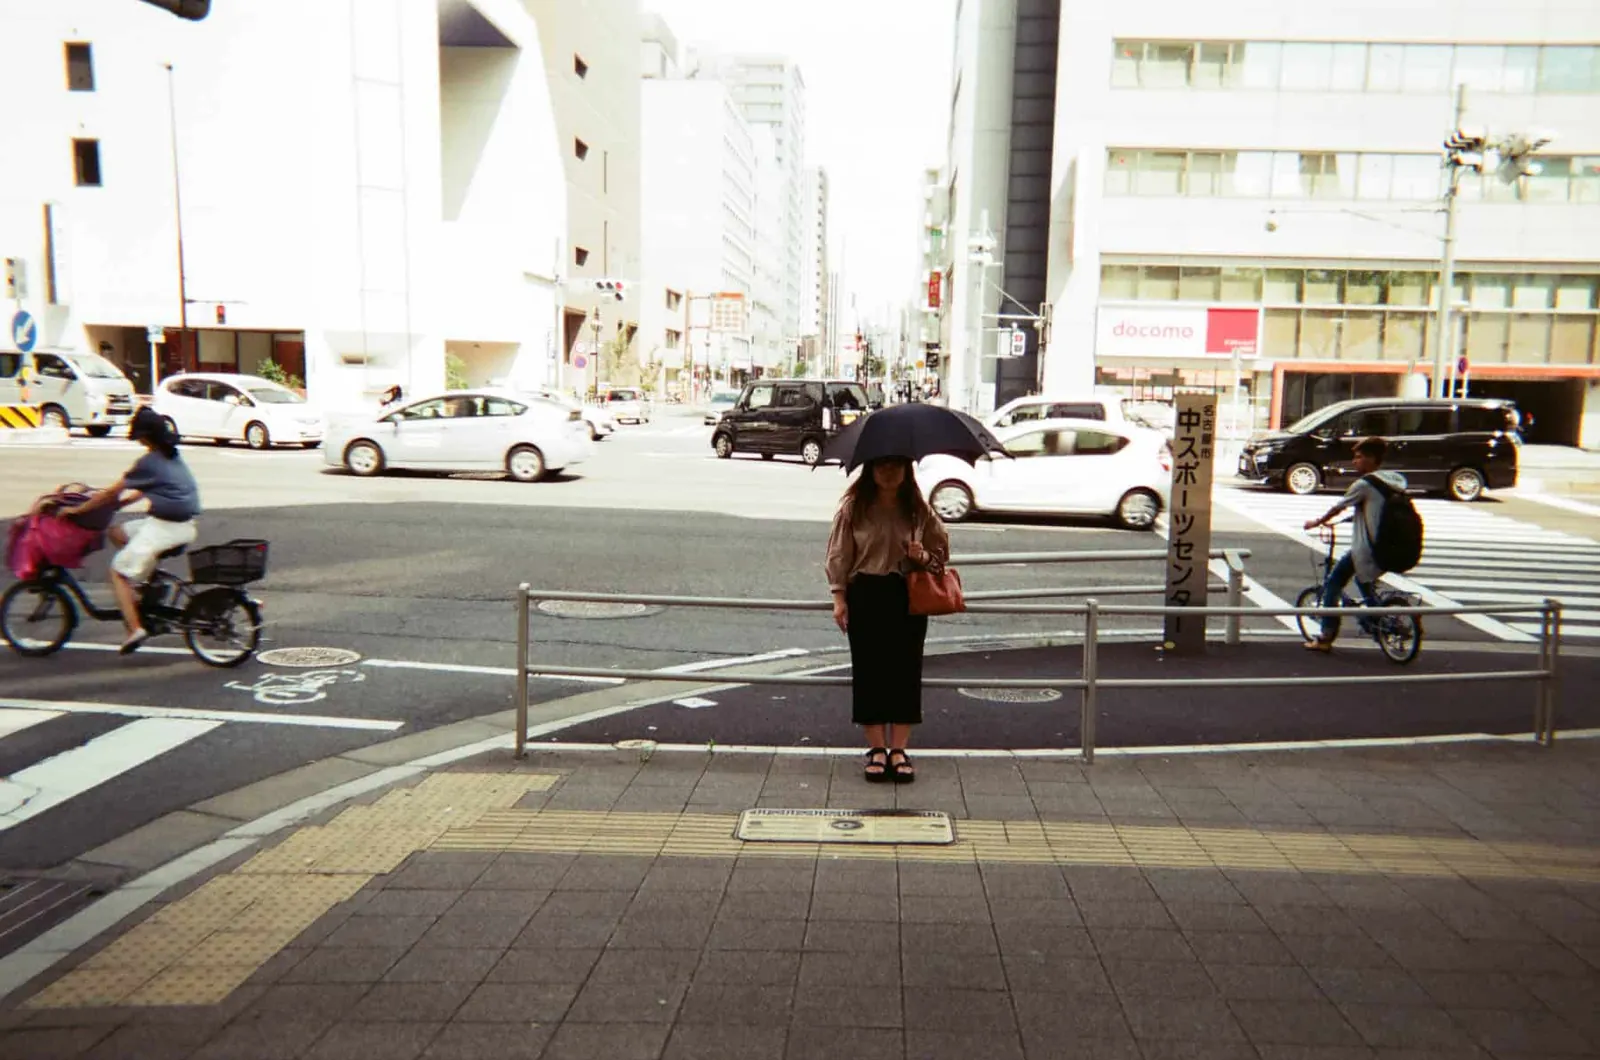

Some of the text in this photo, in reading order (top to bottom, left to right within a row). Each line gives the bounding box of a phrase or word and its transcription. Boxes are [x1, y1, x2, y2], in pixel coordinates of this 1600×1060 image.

[1112, 320, 1194, 339] docomo
[1170, 407, 1201, 633] 中スポーツセンター
